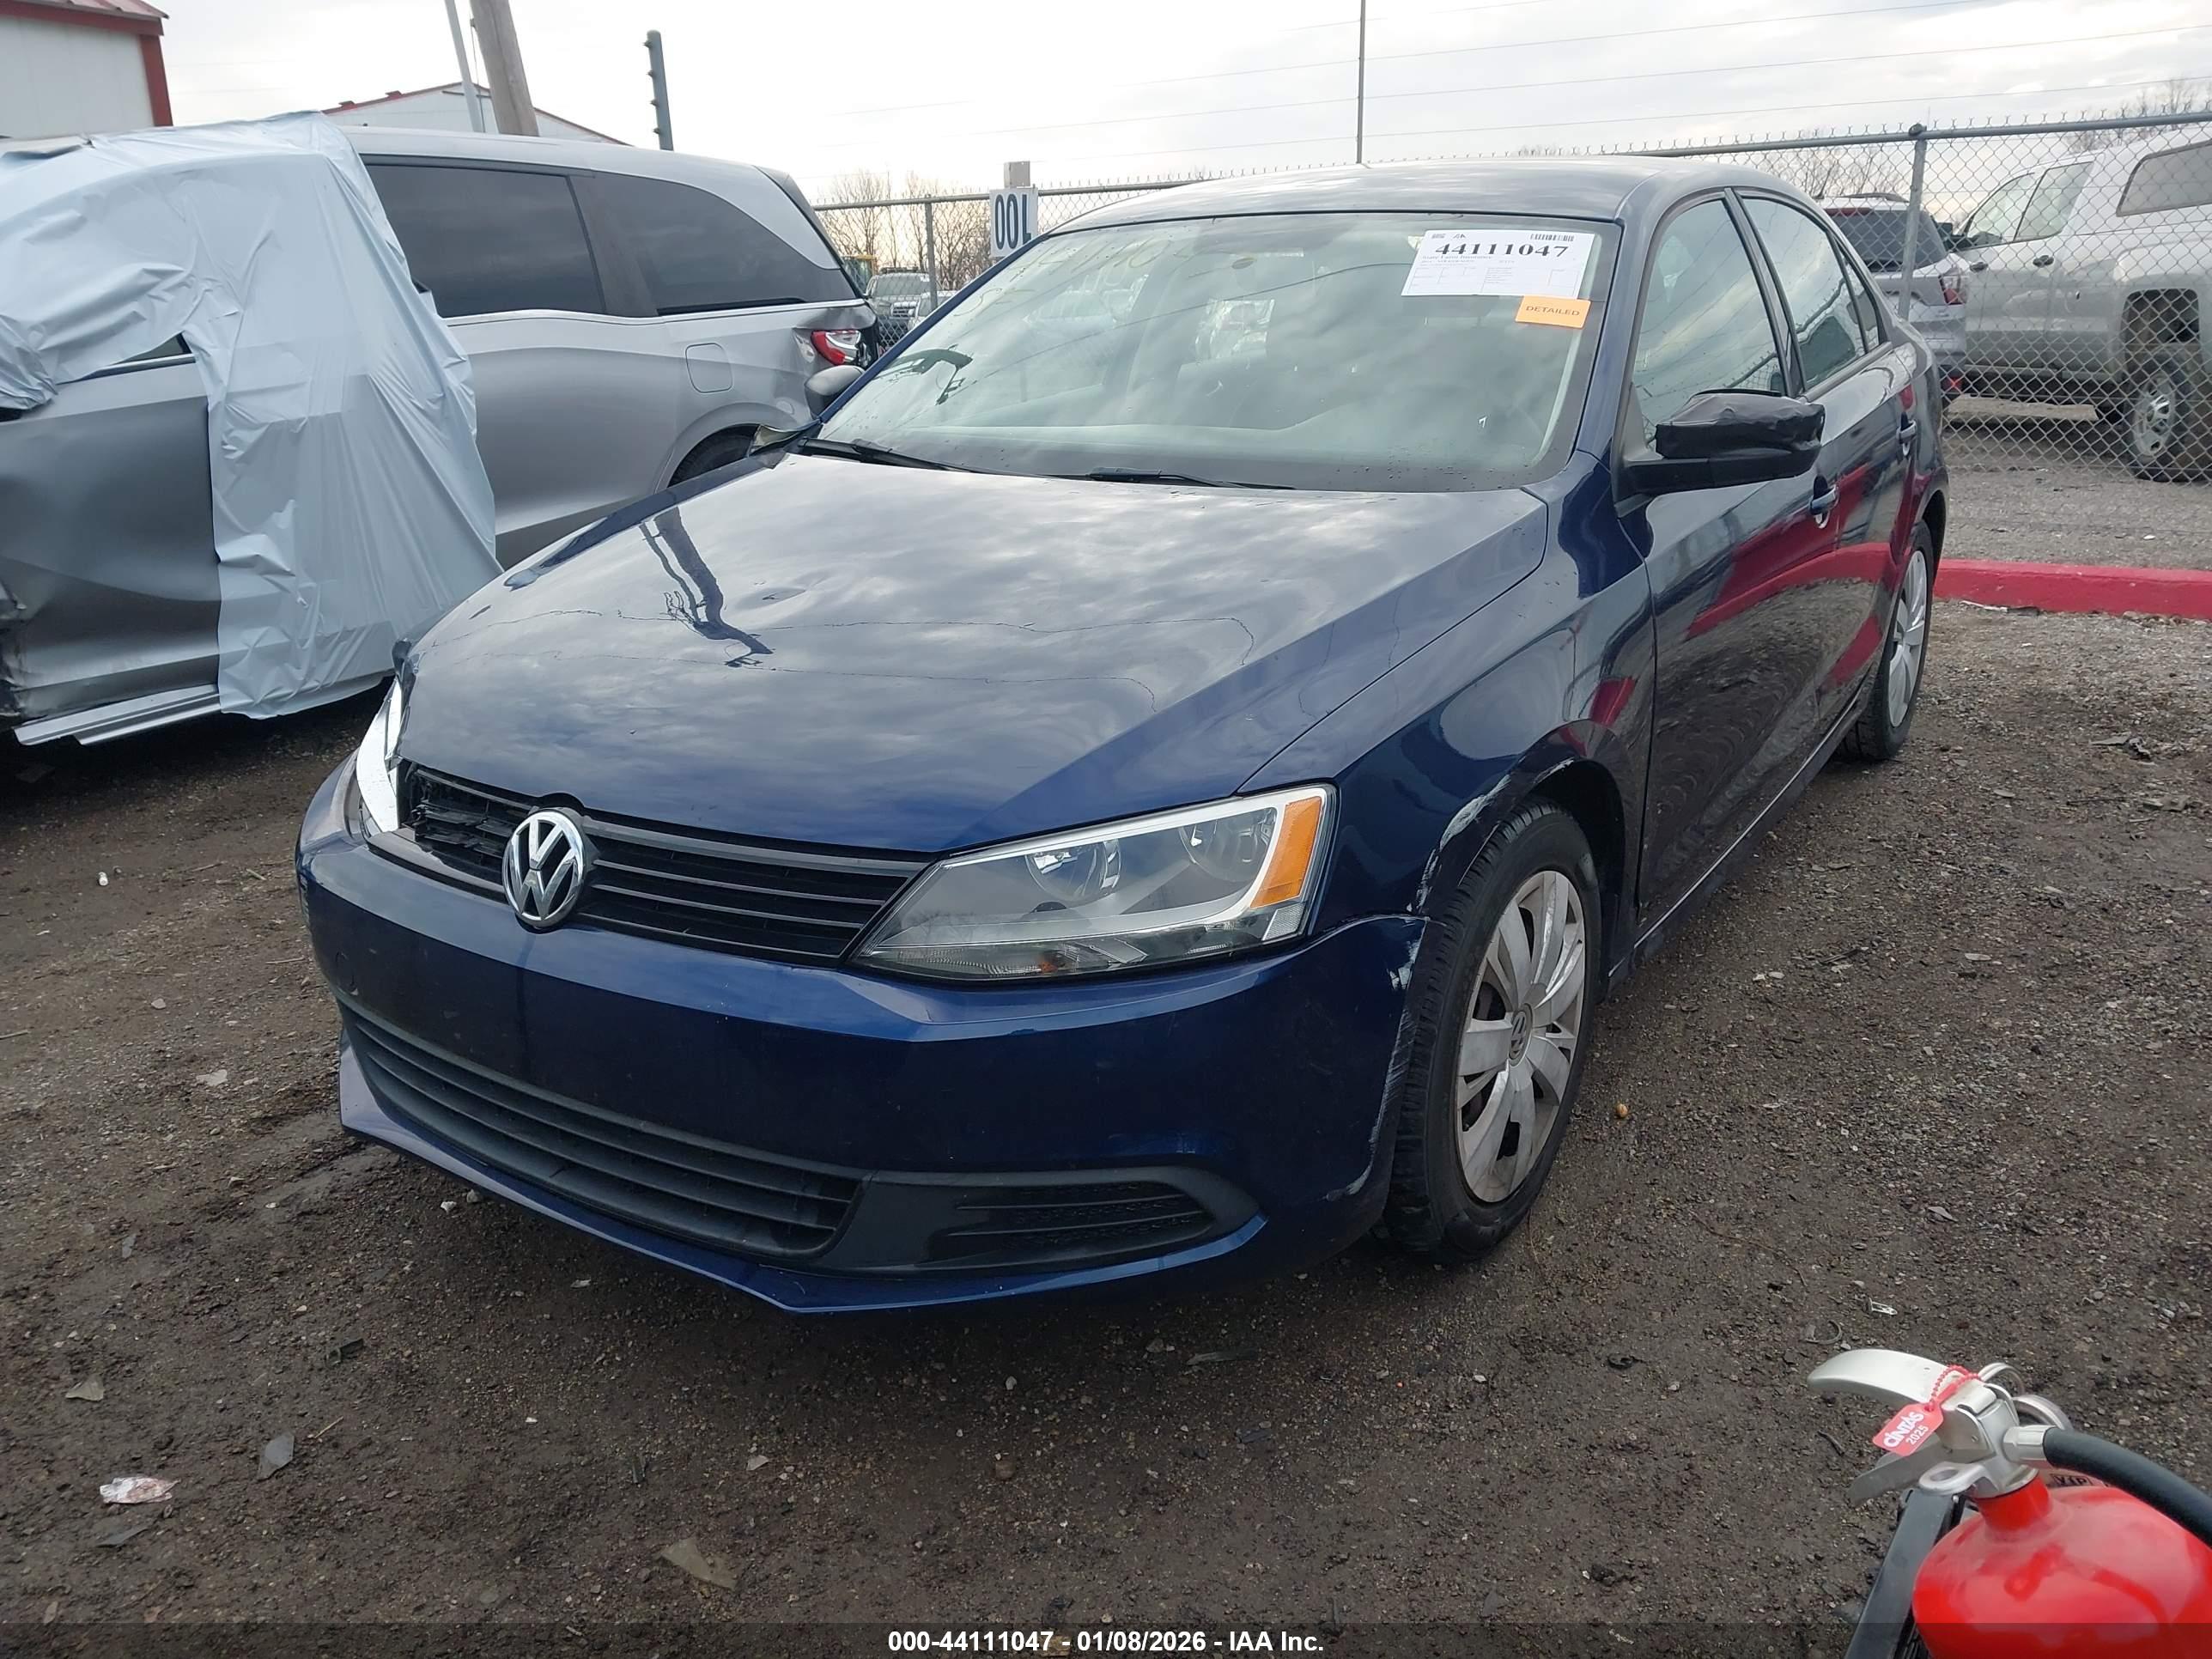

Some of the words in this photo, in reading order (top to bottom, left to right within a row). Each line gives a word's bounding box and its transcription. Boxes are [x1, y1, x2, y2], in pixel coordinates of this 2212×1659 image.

[1435, 243, 1568, 258] 44111047
[1525, 305, 1580, 316] DETAILED
[1905, 1425, 1929, 1445] 2025
